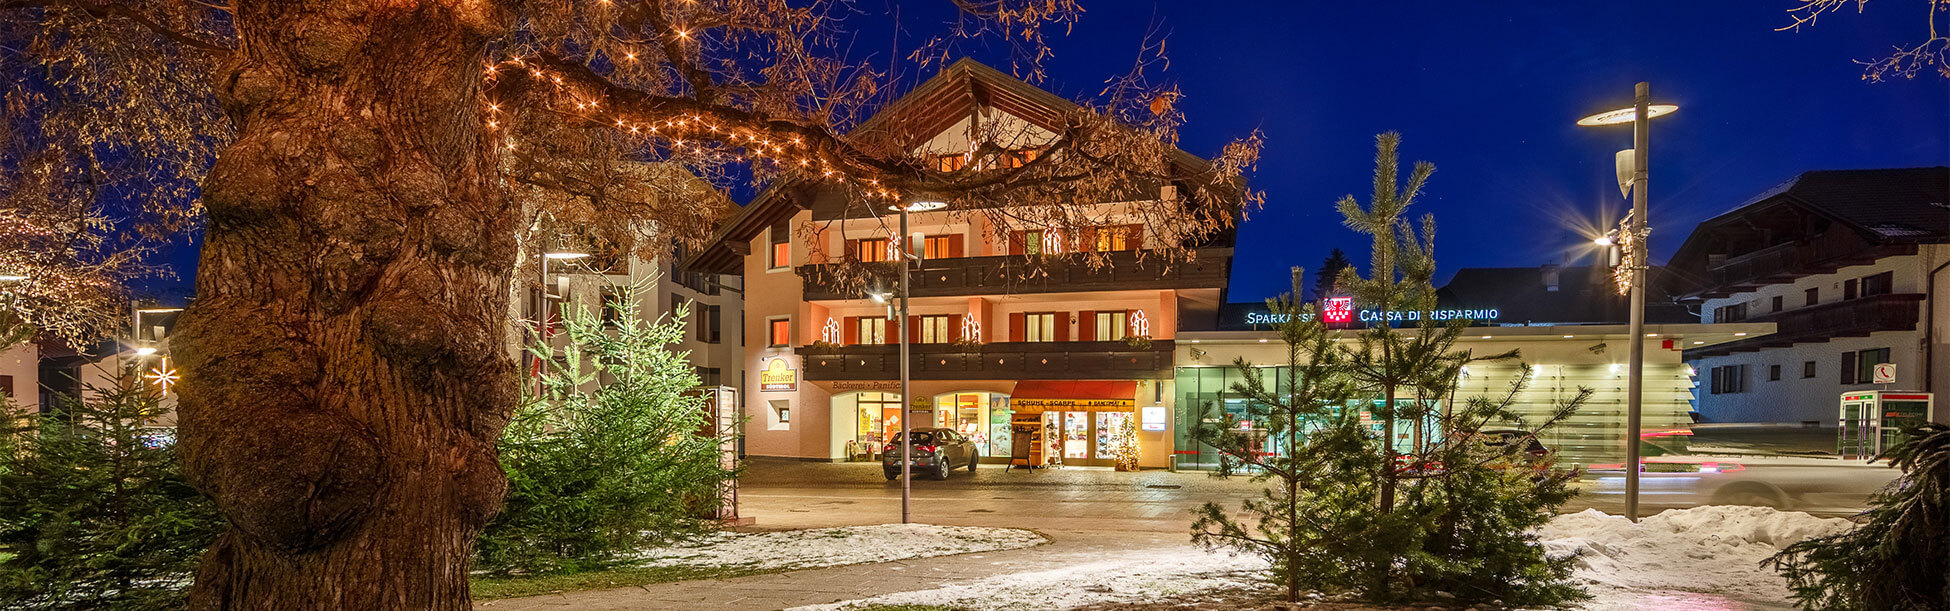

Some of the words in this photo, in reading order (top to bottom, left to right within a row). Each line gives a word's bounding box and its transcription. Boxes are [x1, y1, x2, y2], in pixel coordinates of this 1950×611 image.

[1247, 312, 1316, 324] SPARKASE
[1408, 310, 1421, 321] DI
[763, 373, 794, 383] Trenker
[872, 381, 902, 390] Panific
